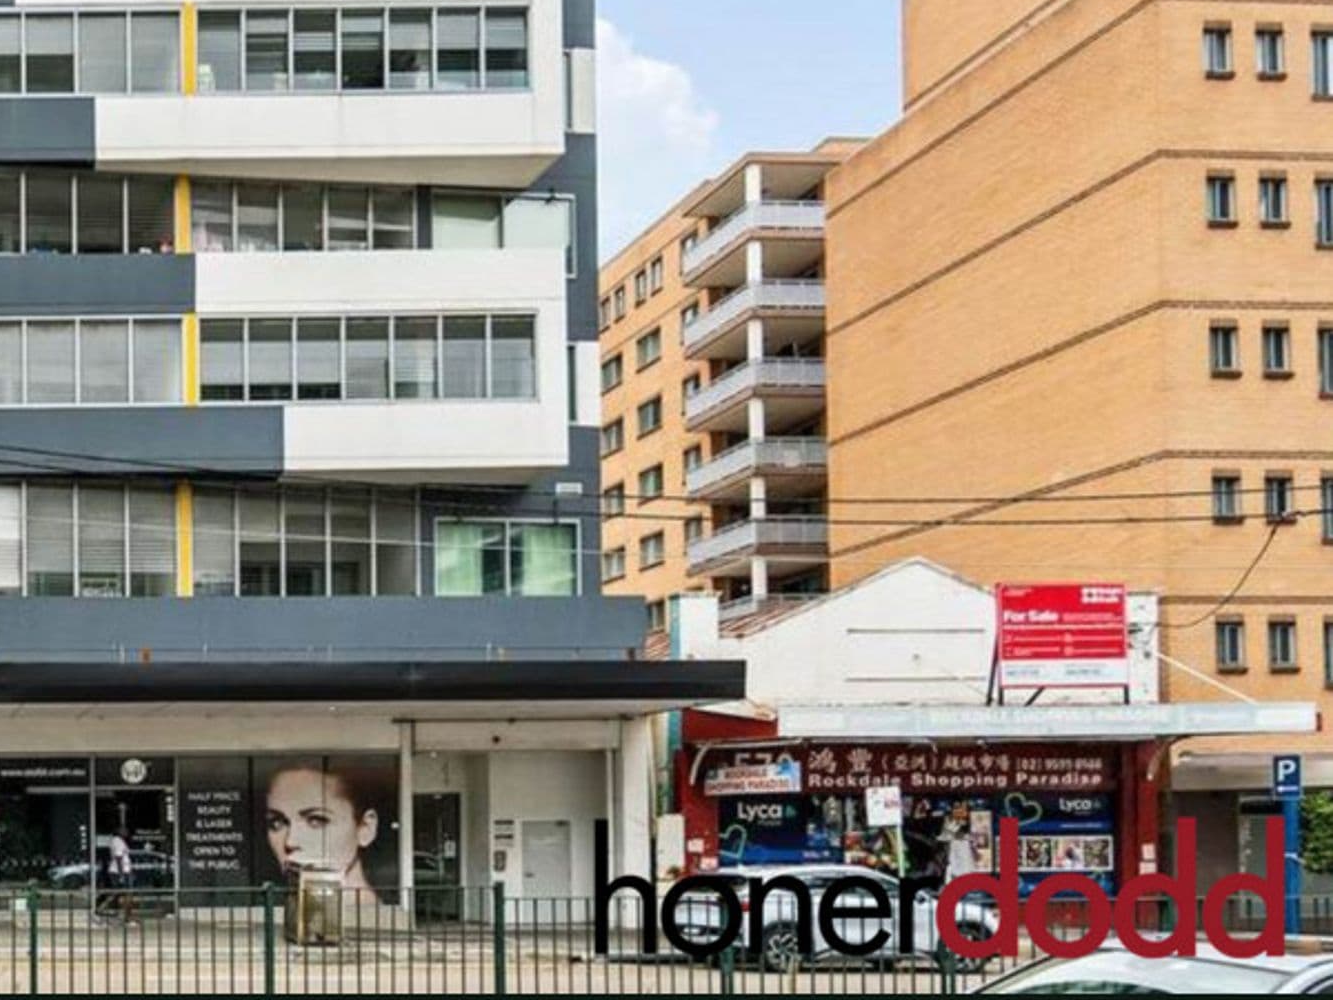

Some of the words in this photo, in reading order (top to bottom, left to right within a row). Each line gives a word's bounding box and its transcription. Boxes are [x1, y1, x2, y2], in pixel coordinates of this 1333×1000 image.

[1004, 611, 1025, 622] For
[1028, 611, 1059, 622] Sale
[1277, 760, 1297, 782] P
[808, 774, 901, 787] Rockdale
[911, 773, 1008, 788] Shopping
[1017, 773, 1102, 786] Paradise
[1059, 798, 1092, 813] Lyca
[737, 802, 783, 823] Lyca
[186, 832, 243, 842] TREATMENTS
[193, 846, 220, 856] OPEN
[221, 846, 236, 856] TO
[188, 859, 206, 870] THE
[207, 859, 241, 870] PUBLIC
